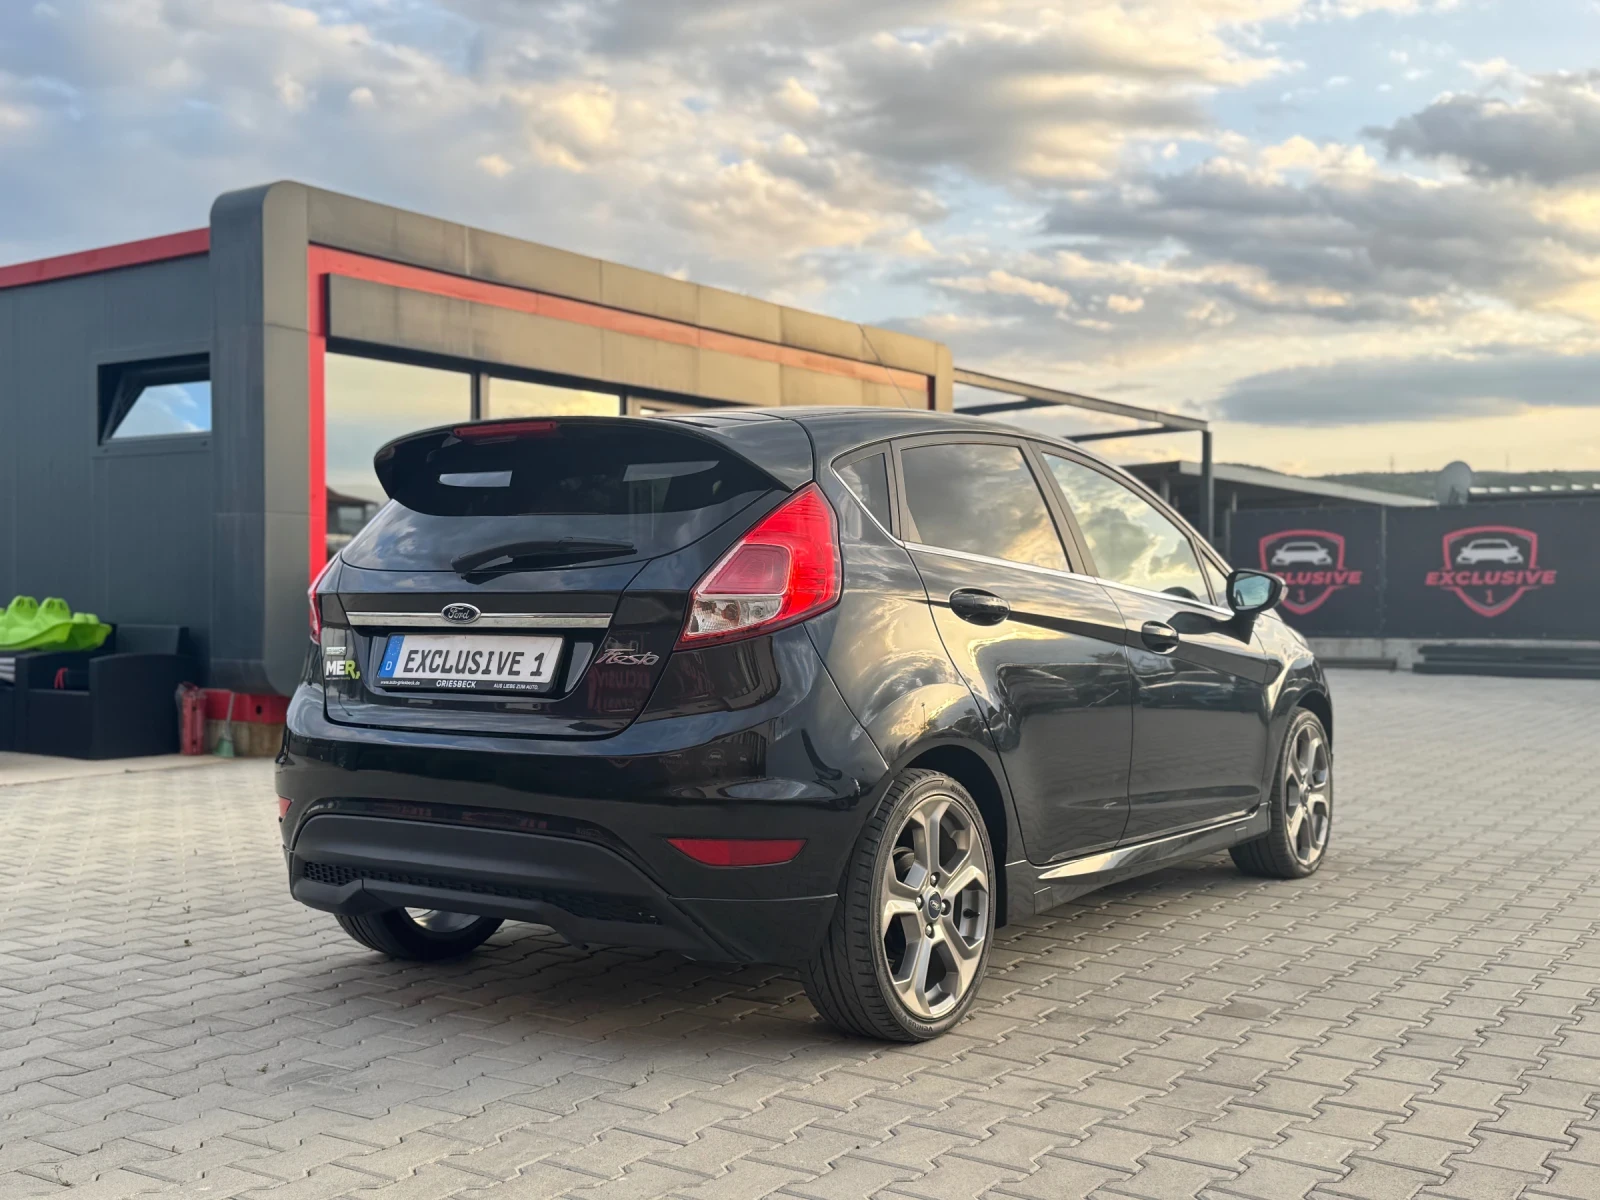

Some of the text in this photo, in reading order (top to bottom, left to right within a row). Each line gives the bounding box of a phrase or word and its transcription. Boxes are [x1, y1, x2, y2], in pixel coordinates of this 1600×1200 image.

[1275, 571, 1362, 585] LUSIVE
[1425, 570, 1557, 585] EXCLUSIVE
[1485, 590, 1494, 603] 1
[448, 606, 470, 619] Ford
[385, 660, 393, 671] D
[403, 649, 544, 676] EXCLUSIVE 1
[436, 680, 477, 688] GRIESBECK
